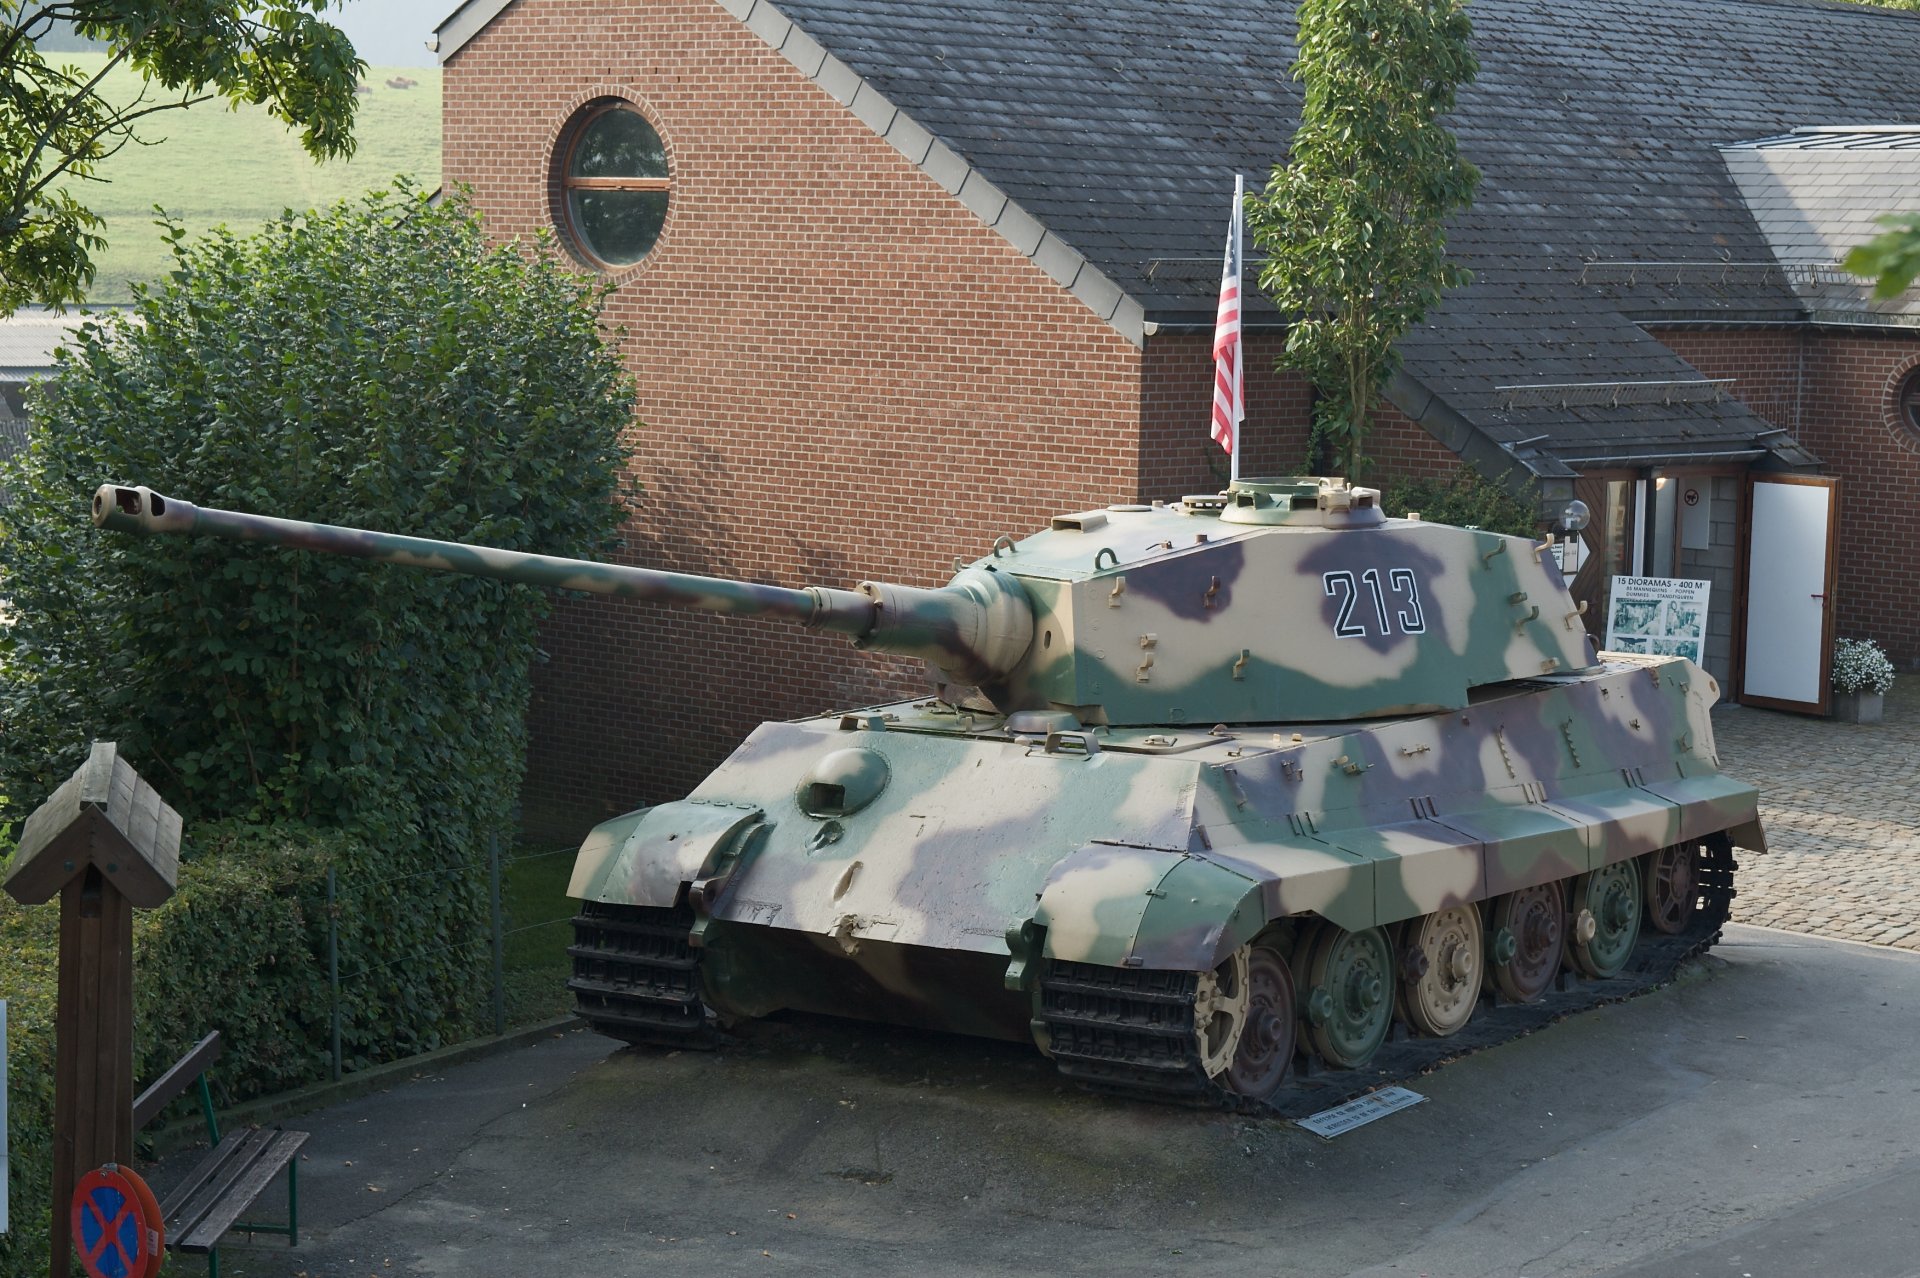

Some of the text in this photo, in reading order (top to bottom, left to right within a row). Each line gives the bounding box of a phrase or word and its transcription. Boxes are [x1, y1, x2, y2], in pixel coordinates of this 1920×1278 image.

[1323, 568, 1425, 639] 213
[1617, 577, 1626, 585] 15
[1628, 577, 1672, 588] DIORAMAS
[1678, 581, 1693, 589] 400
